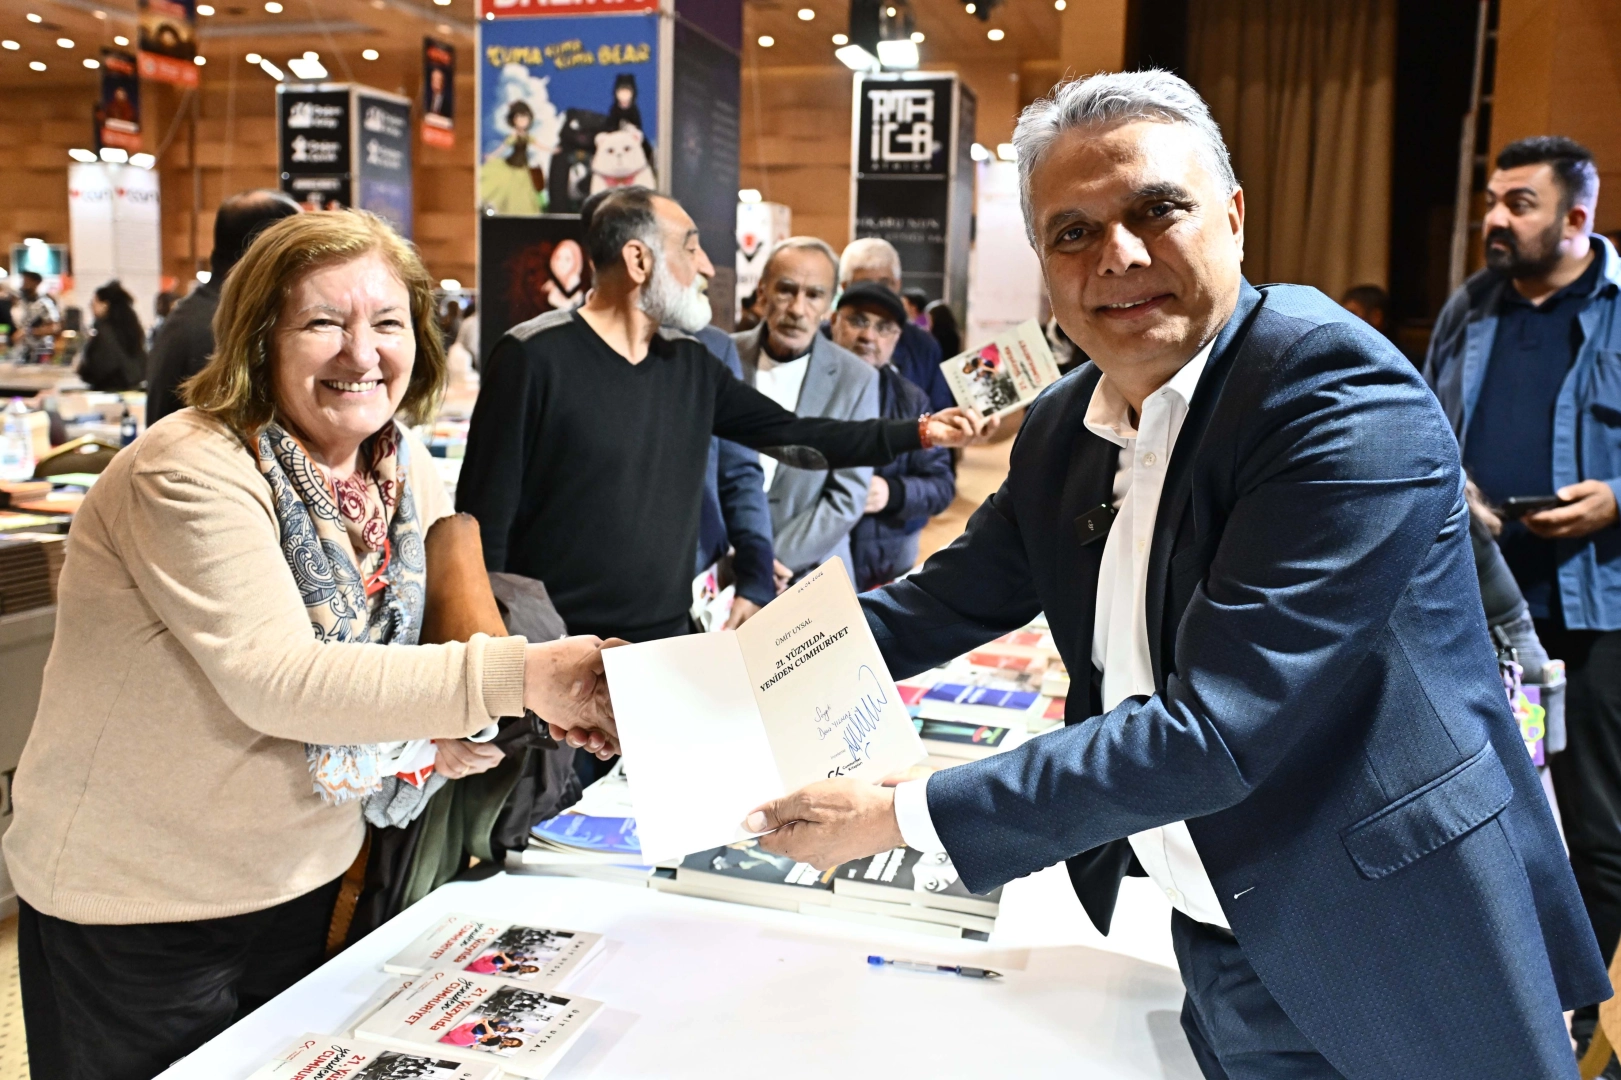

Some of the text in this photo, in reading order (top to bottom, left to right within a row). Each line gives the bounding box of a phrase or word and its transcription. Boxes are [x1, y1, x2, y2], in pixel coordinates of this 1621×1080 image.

[598, 42, 651, 65] BEAR
[774, 618, 813, 647] ÜMİT UYSAL
[760, 626, 849, 692] YENİDEN CUMHURİYET
[775, 631, 826, 670] 21. YÜZYILDA
[429, 924, 474, 960] CUMHURİYET
[453, 937, 490, 963] Yüzyılda
[404, 981, 461, 1026] CUMHURİYET
[429, 987, 488, 1031] 21. Yüzyılda
[441, 977, 475, 1011] yeniden
[343, 1054, 366, 1067] 21.
